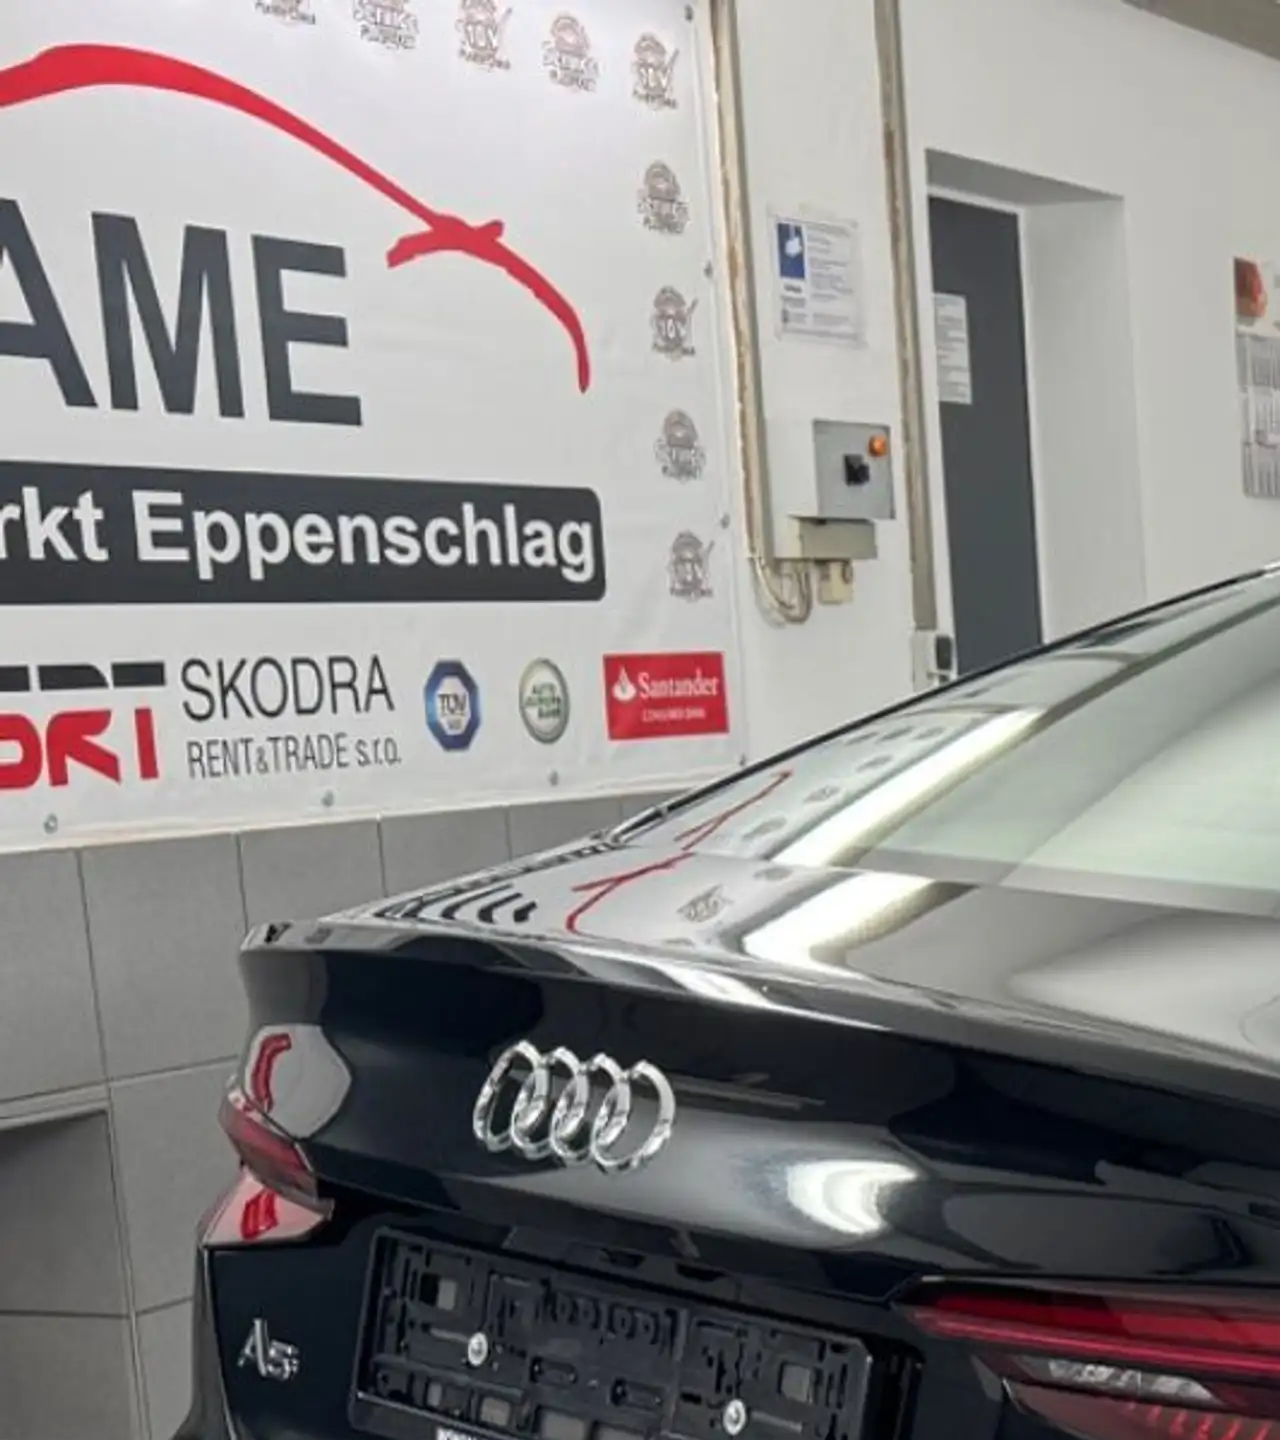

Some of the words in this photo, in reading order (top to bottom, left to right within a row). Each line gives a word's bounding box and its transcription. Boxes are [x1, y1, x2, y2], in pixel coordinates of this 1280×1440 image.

[132, 488, 595, 581] Eppenschlag
[181, 655, 395, 721] SKODRA
[638, 667, 719, 699] Santander
[236, 1317, 299, 1379] A5
